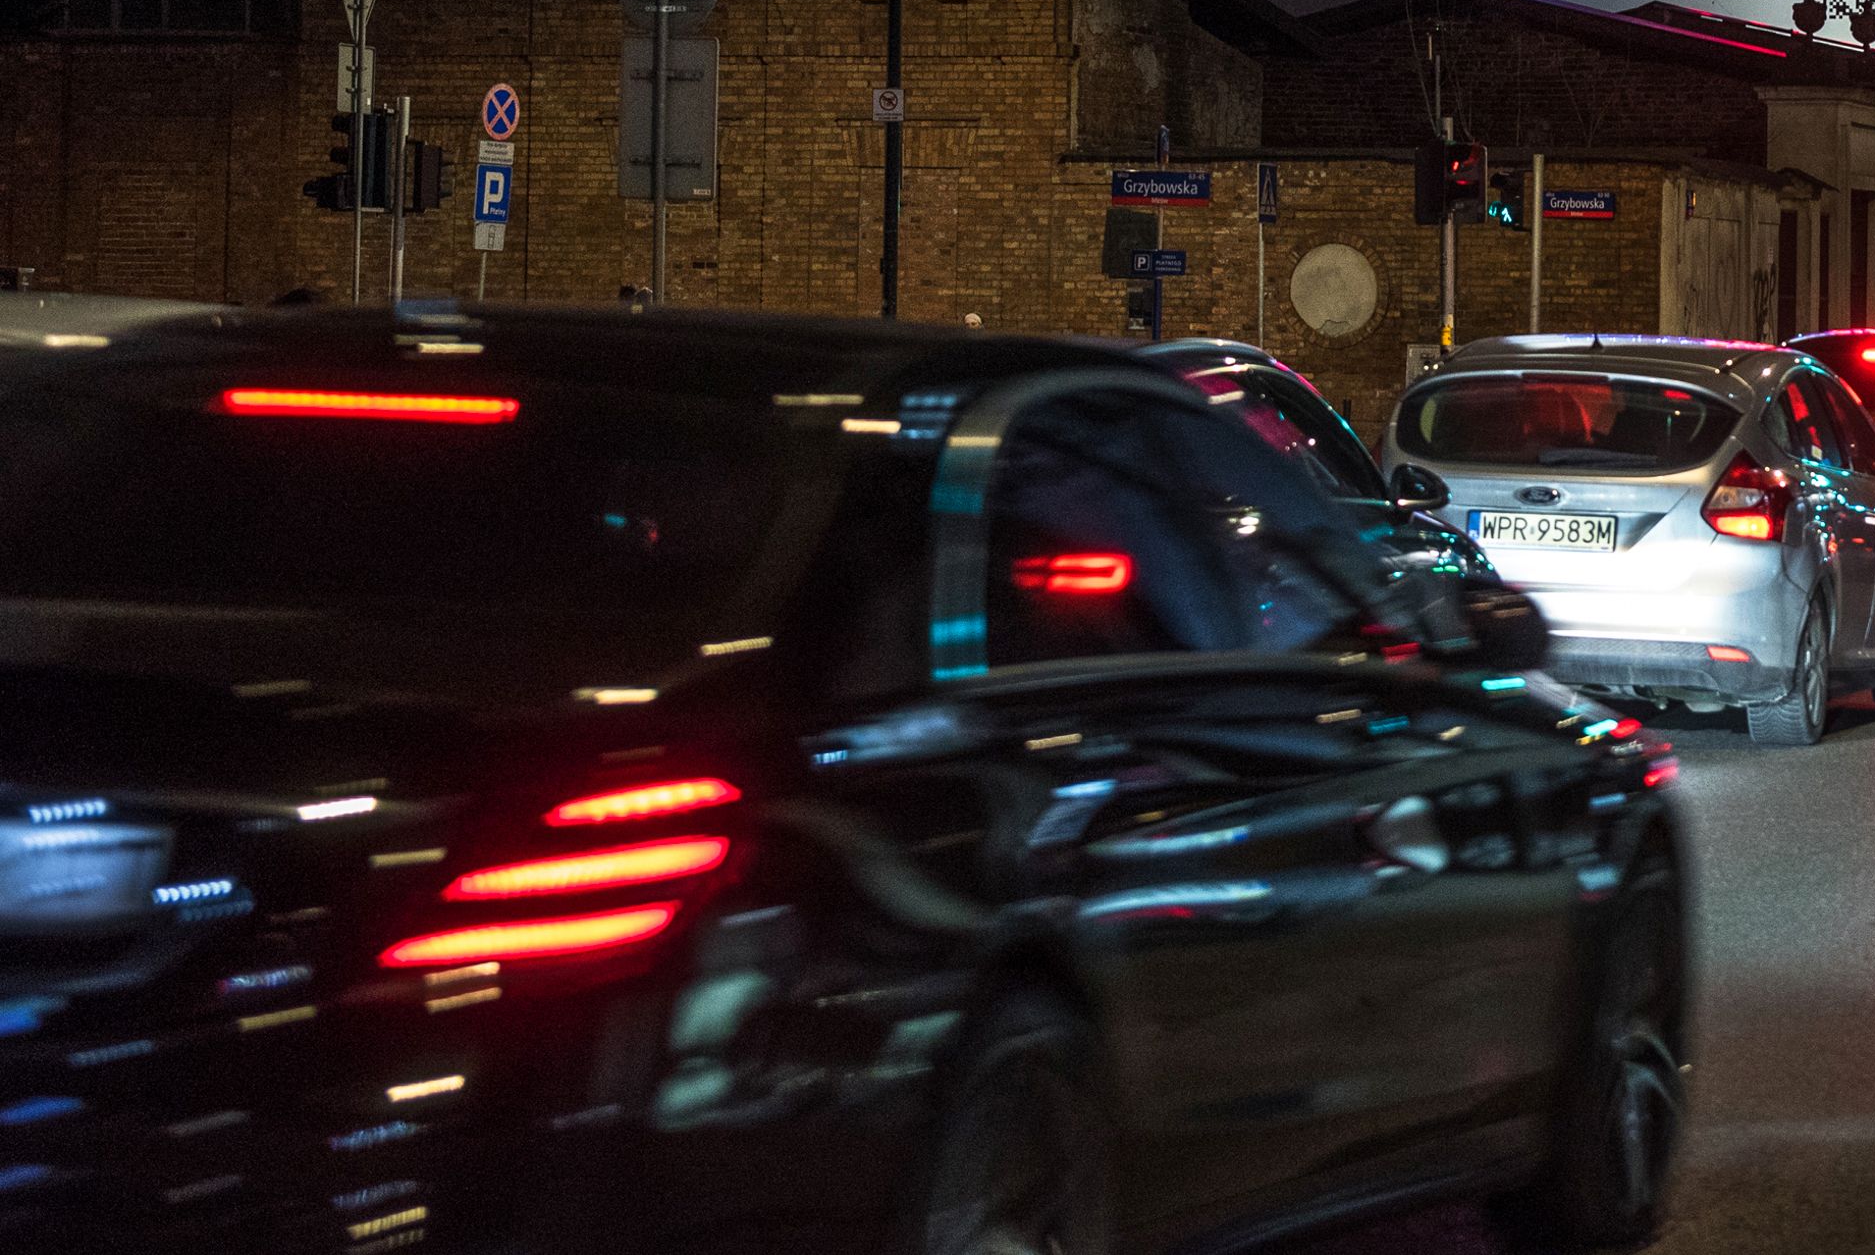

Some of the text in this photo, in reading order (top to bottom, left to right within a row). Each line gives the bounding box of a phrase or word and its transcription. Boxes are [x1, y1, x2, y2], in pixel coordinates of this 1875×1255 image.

[483, 172, 504, 214] P
[1123, 179, 1199, 197] Grzybowska
[1550, 197, 1605, 211] Grzybowska
[1137, 256, 1147, 268] P
[1482, 516, 1613, 545] WPR 9583M
